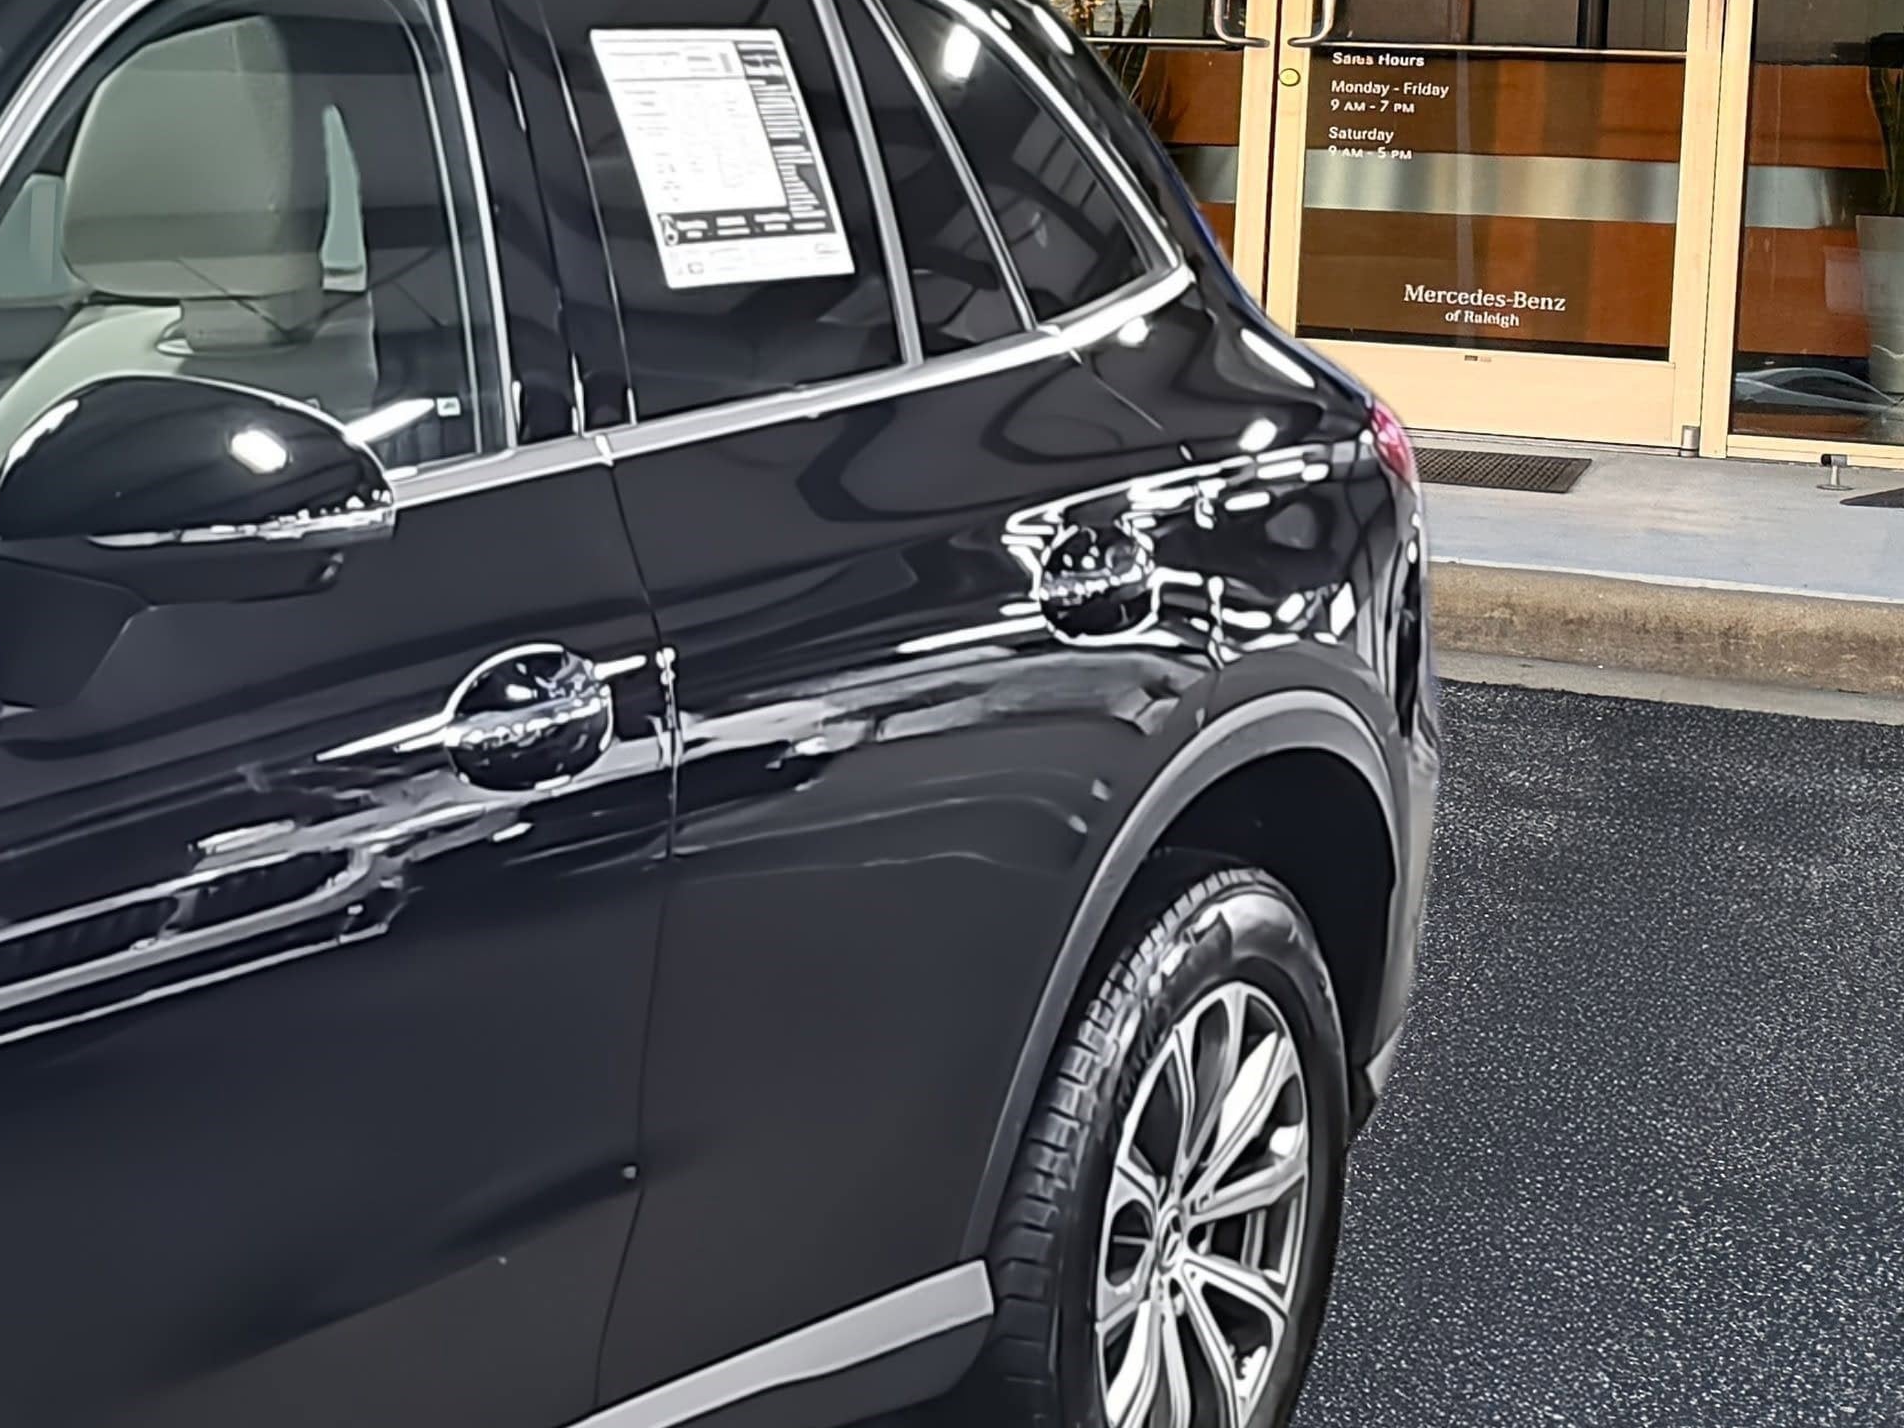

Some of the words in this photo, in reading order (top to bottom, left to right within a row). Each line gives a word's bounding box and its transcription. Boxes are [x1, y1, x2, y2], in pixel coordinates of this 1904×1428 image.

[1378, 53, 1425, 67] Hours
[1331, 80, 1390, 97] Monday
[1403, 82, 1449, 99] Friday
[1330, 99, 1340, 111] 9
[1343, 101, 1366, 112] AM
[1379, 100, 1389, 112] 7
[1393, 103, 1415, 113] PM
[1328, 126, 1394, 144] Saturday
[1328, 145, 1337, 157] 9
[1341, 148, 1363, 158] AM
[1377, 146, 1387, 159] 5
[1391, 149, 1412, 160] PM
[1403, 283, 1566, 312] Mercedes-Benz
[1444, 309, 1462, 322] of
[1463, 310, 1520, 328] Raleigh
